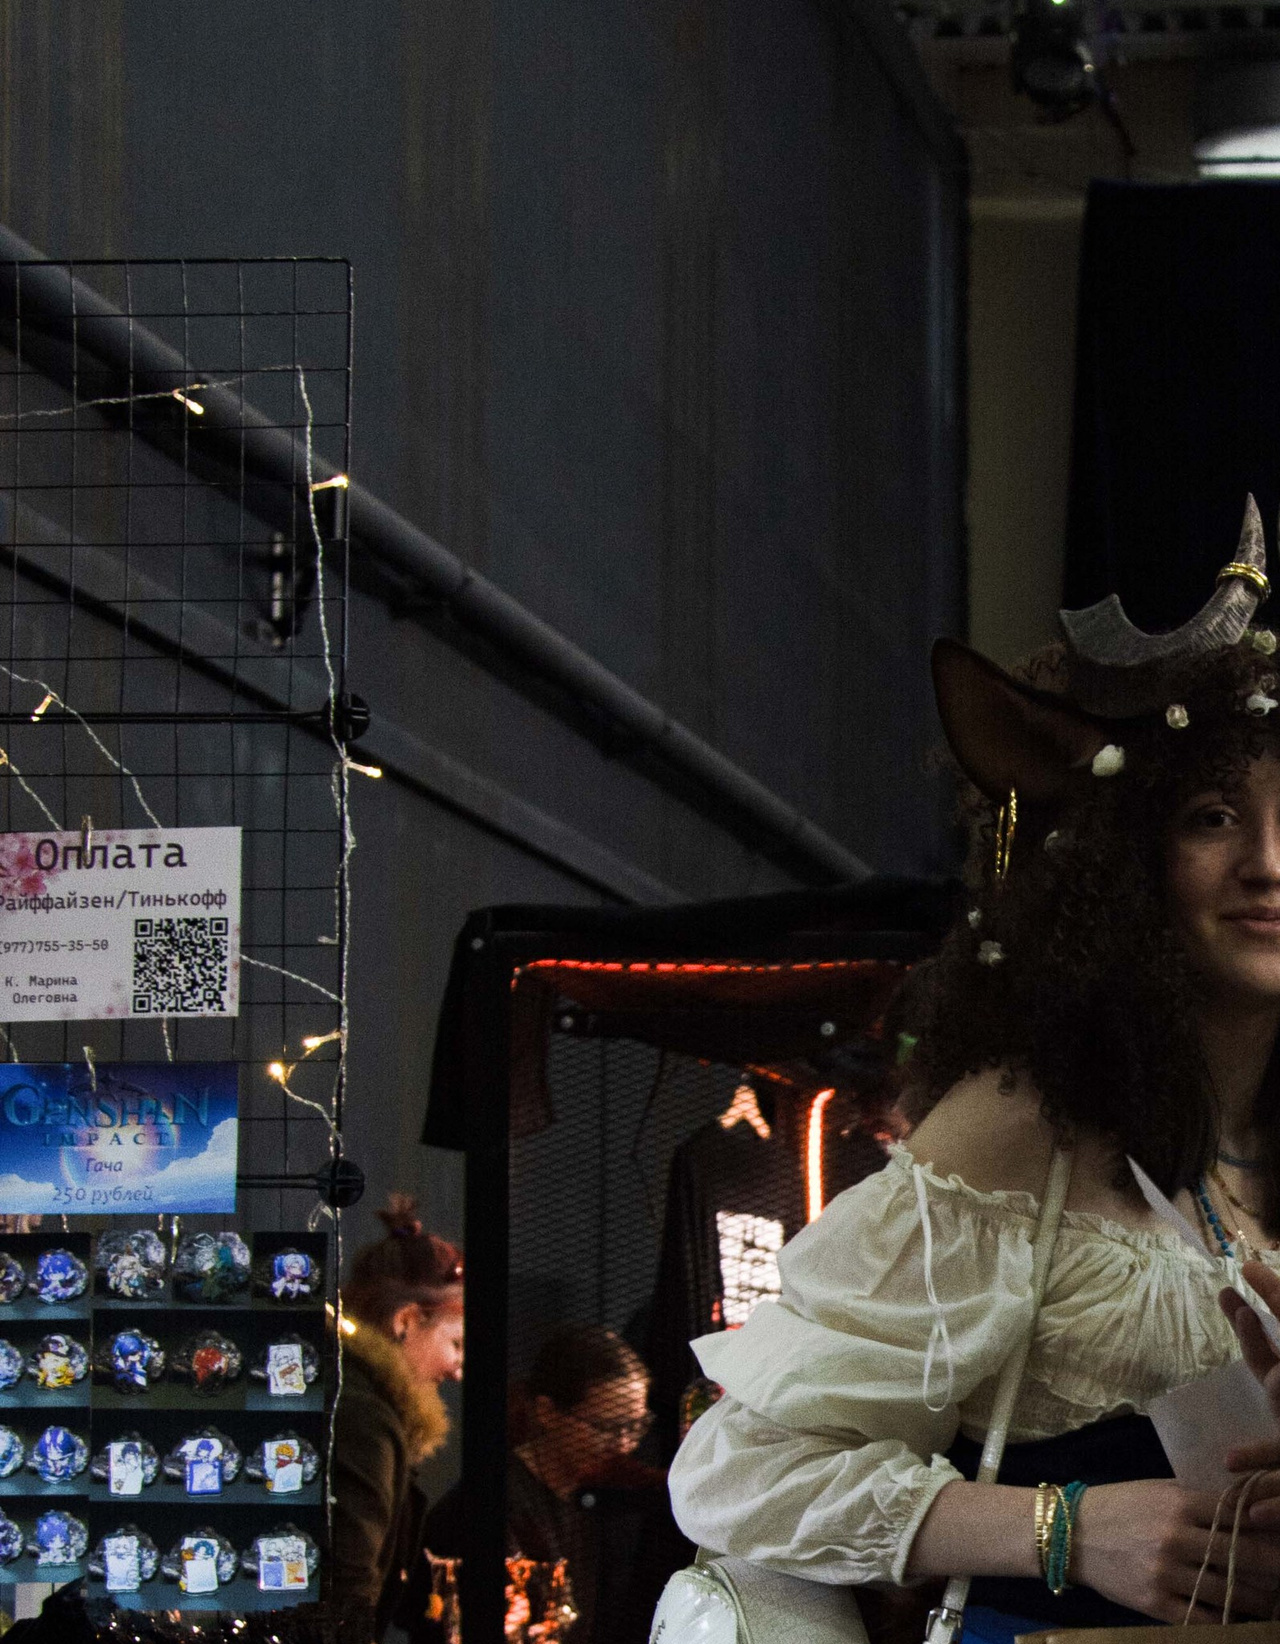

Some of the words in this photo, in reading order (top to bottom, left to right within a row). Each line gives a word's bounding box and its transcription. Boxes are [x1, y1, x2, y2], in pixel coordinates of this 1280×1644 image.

[35, 838, 188, 871] Оплата
[29, 975, 78, 988] Марина
[12, 992, 78, 1004] Олеговна
[42, 1132, 169, 1146] IMPACT
[85, 1157, 123, 1172] Гача
[52, 1186, 86, 1205] 250
[90, 1185, 154, 1205] рублей
